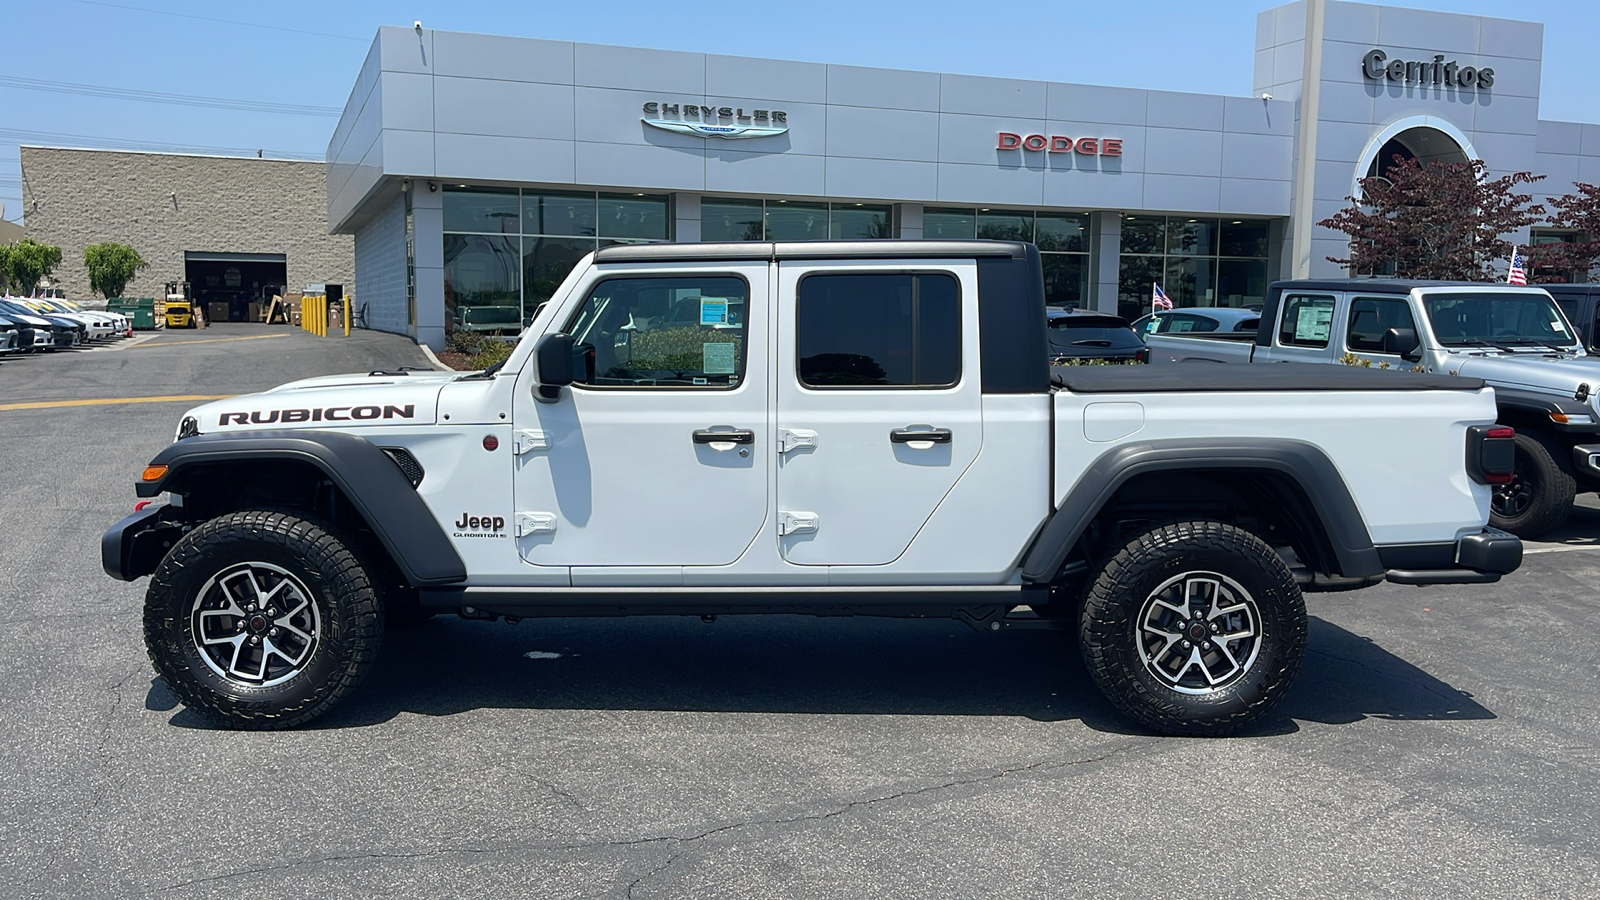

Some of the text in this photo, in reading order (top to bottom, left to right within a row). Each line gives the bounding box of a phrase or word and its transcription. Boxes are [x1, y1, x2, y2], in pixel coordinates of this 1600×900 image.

[1362, 49, 1494, 89] Cerritos
[643, 102, 787, 123] CHRYSLER
[996, 132, 1123, 157] DODGE
[218, 404, 415, 426] RUBICON
[455, 512, 504, 531] Jeep
